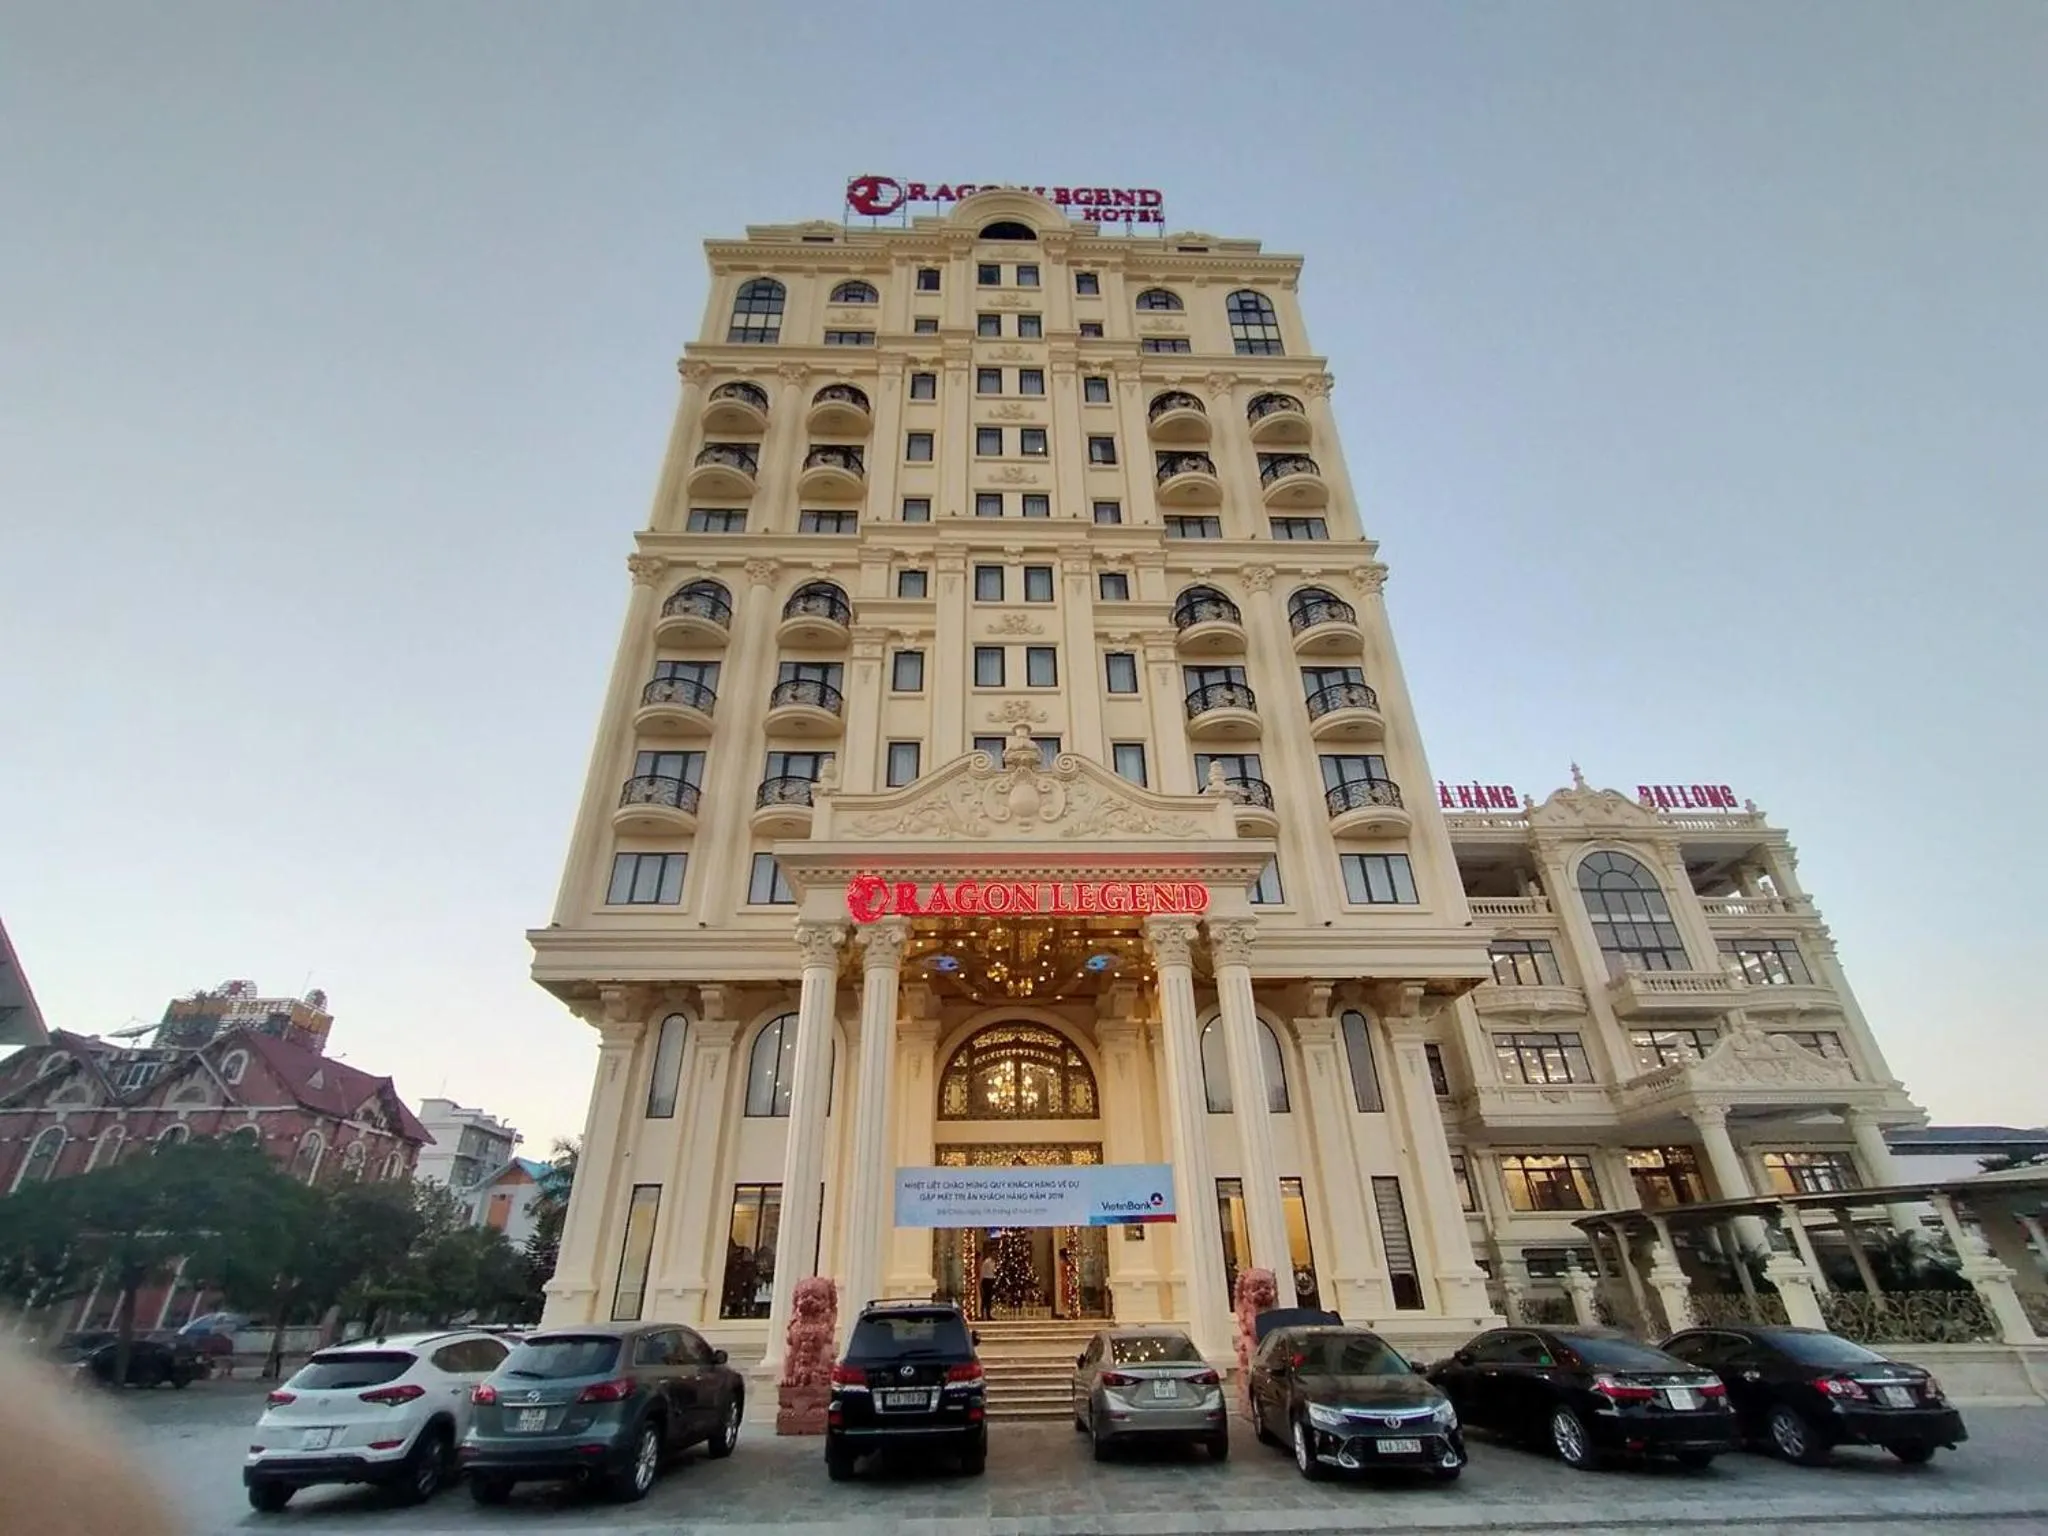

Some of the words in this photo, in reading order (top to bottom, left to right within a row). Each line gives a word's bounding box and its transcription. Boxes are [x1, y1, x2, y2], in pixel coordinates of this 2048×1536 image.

[1083, 208, 1164, 222] HOTEL
[1456, 780, 1519, 808] HÀNG
[1678, 784, 1739, 808] LONG
[1050, 881, 1211, 913] LEGEND
[1101, 1200, 1151, 1211] VietinBank
